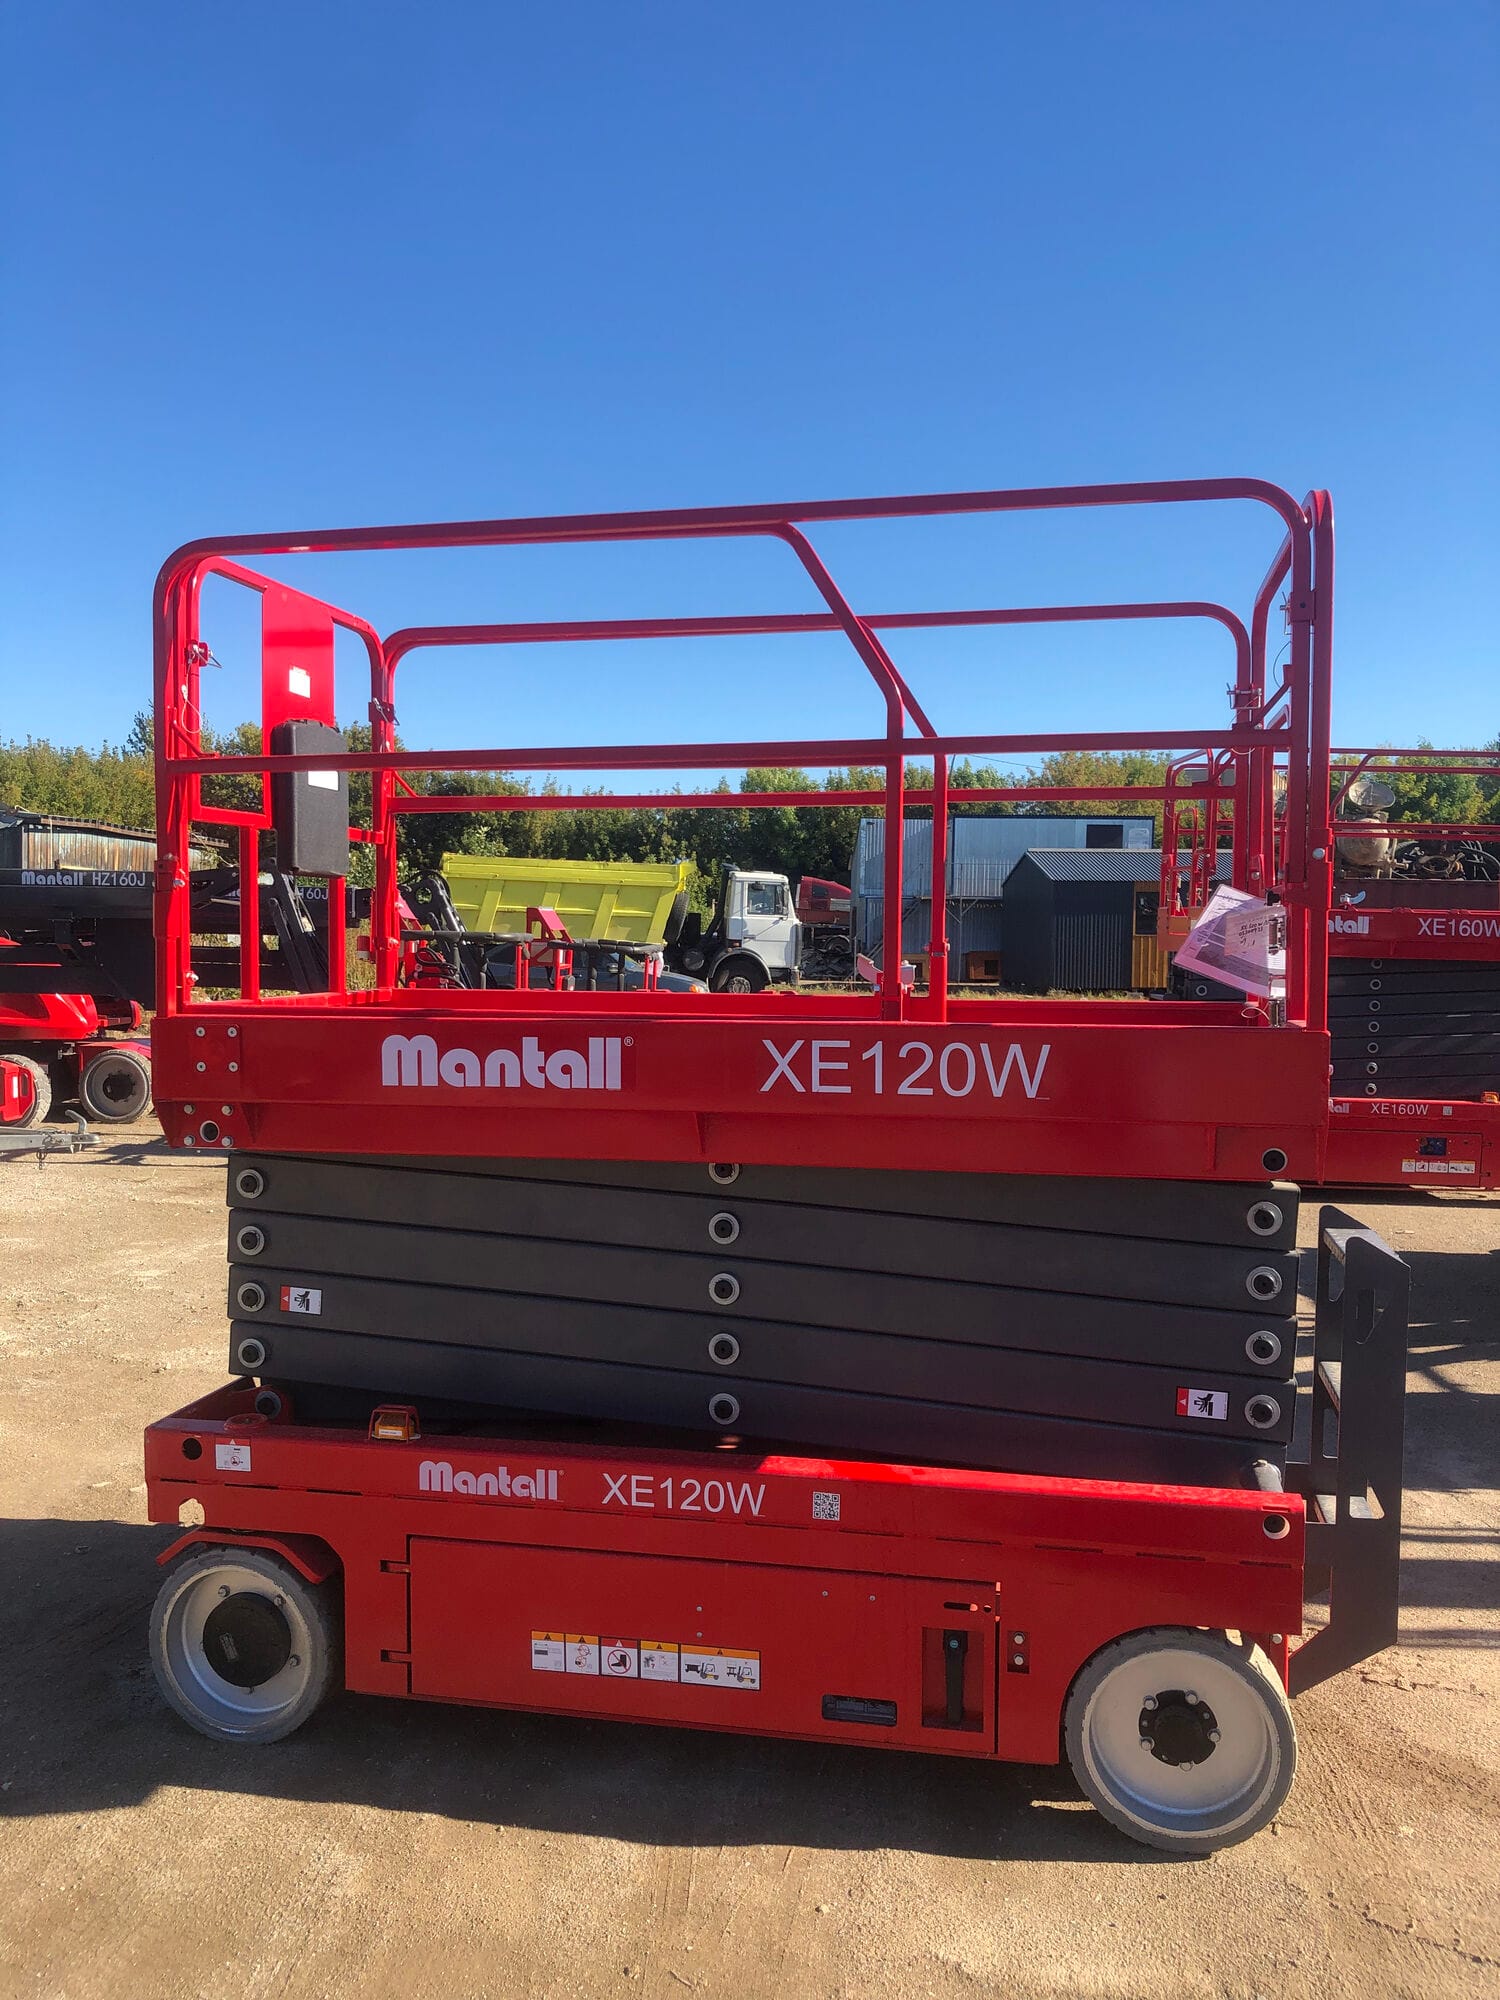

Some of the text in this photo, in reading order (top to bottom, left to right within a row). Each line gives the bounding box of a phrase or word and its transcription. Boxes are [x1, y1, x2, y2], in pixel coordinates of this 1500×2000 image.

[21, 871, 146, 886] Mantall HZ160J
[381, 1034, 1051, 1099] Mantall XE120W
[1370, 1102, 1429, 1116] XE160W
[418, 1460, 767, 1517] Mantall XE120W
